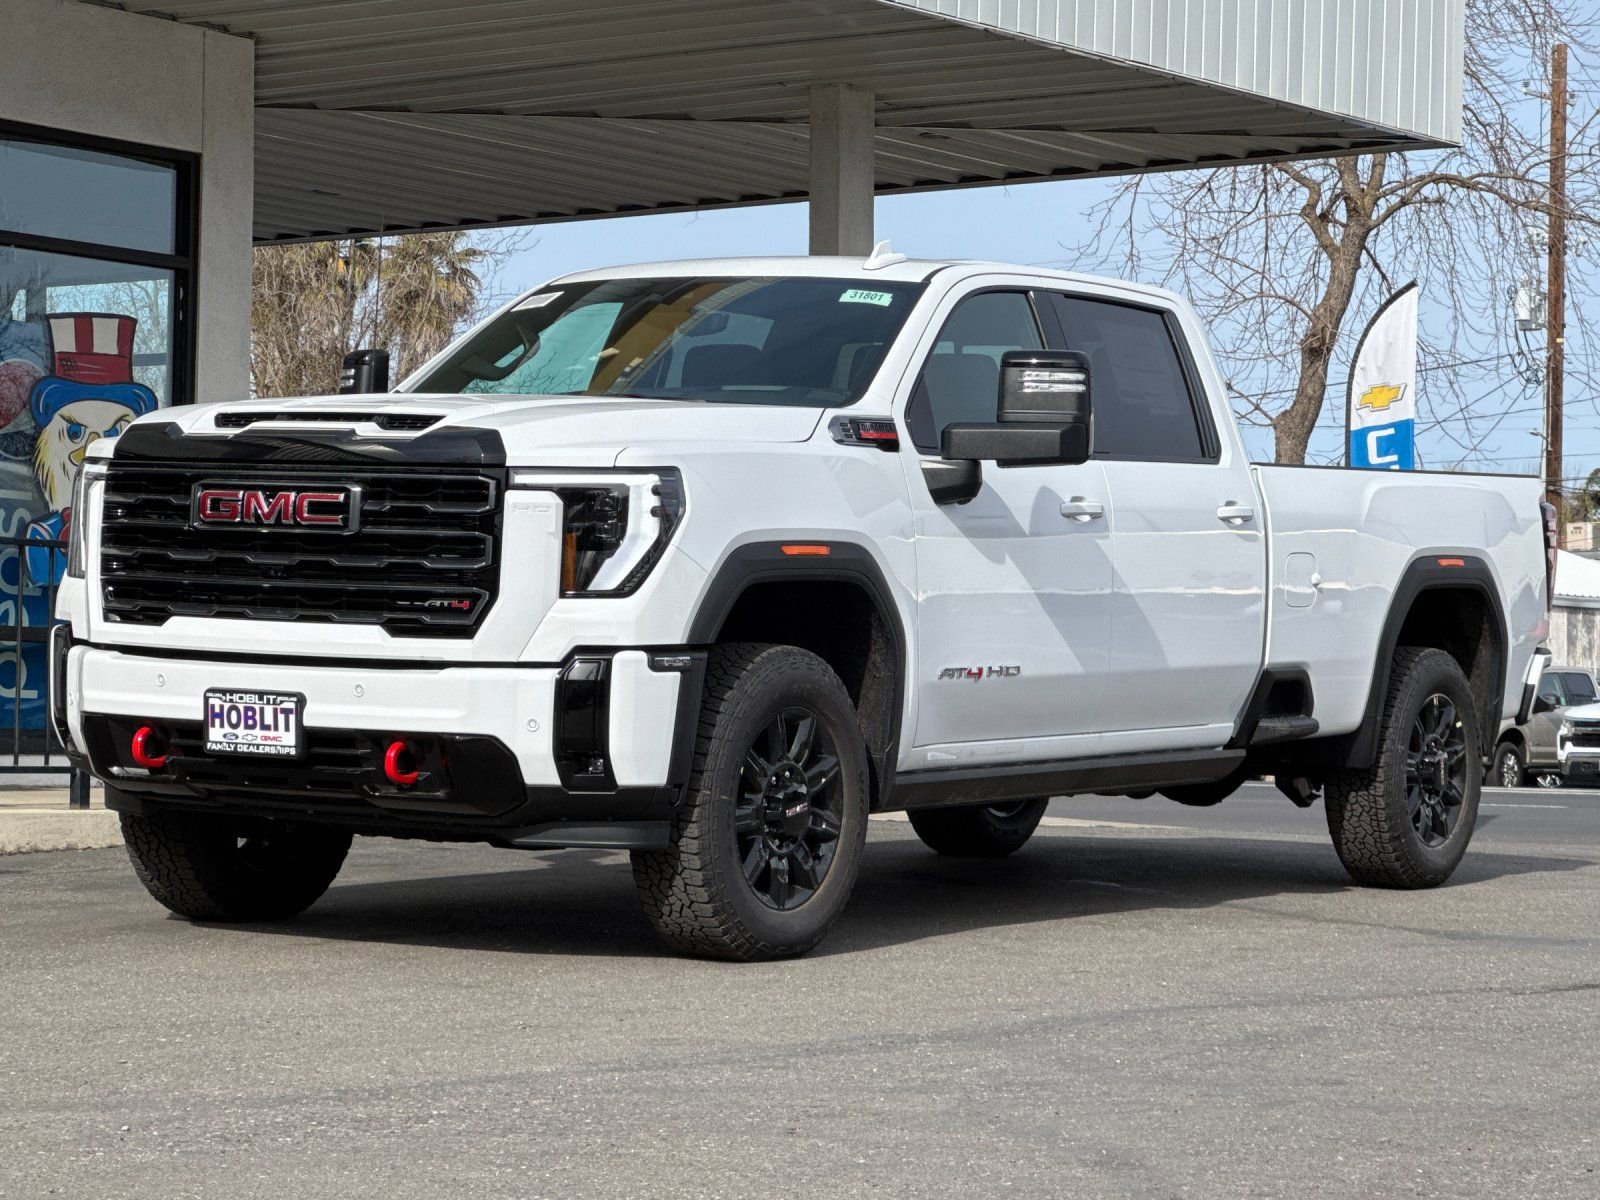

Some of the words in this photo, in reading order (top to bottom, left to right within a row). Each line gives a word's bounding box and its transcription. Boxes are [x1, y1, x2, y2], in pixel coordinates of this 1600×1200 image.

[850, 290, 885, 302] 31801
[198, 490, 345, 526] GMC
[423, 599, 470, 611] AT4
[226, 693, 276, 704] HOBLIT
[210, 703, 294, 732] HOBLIT
